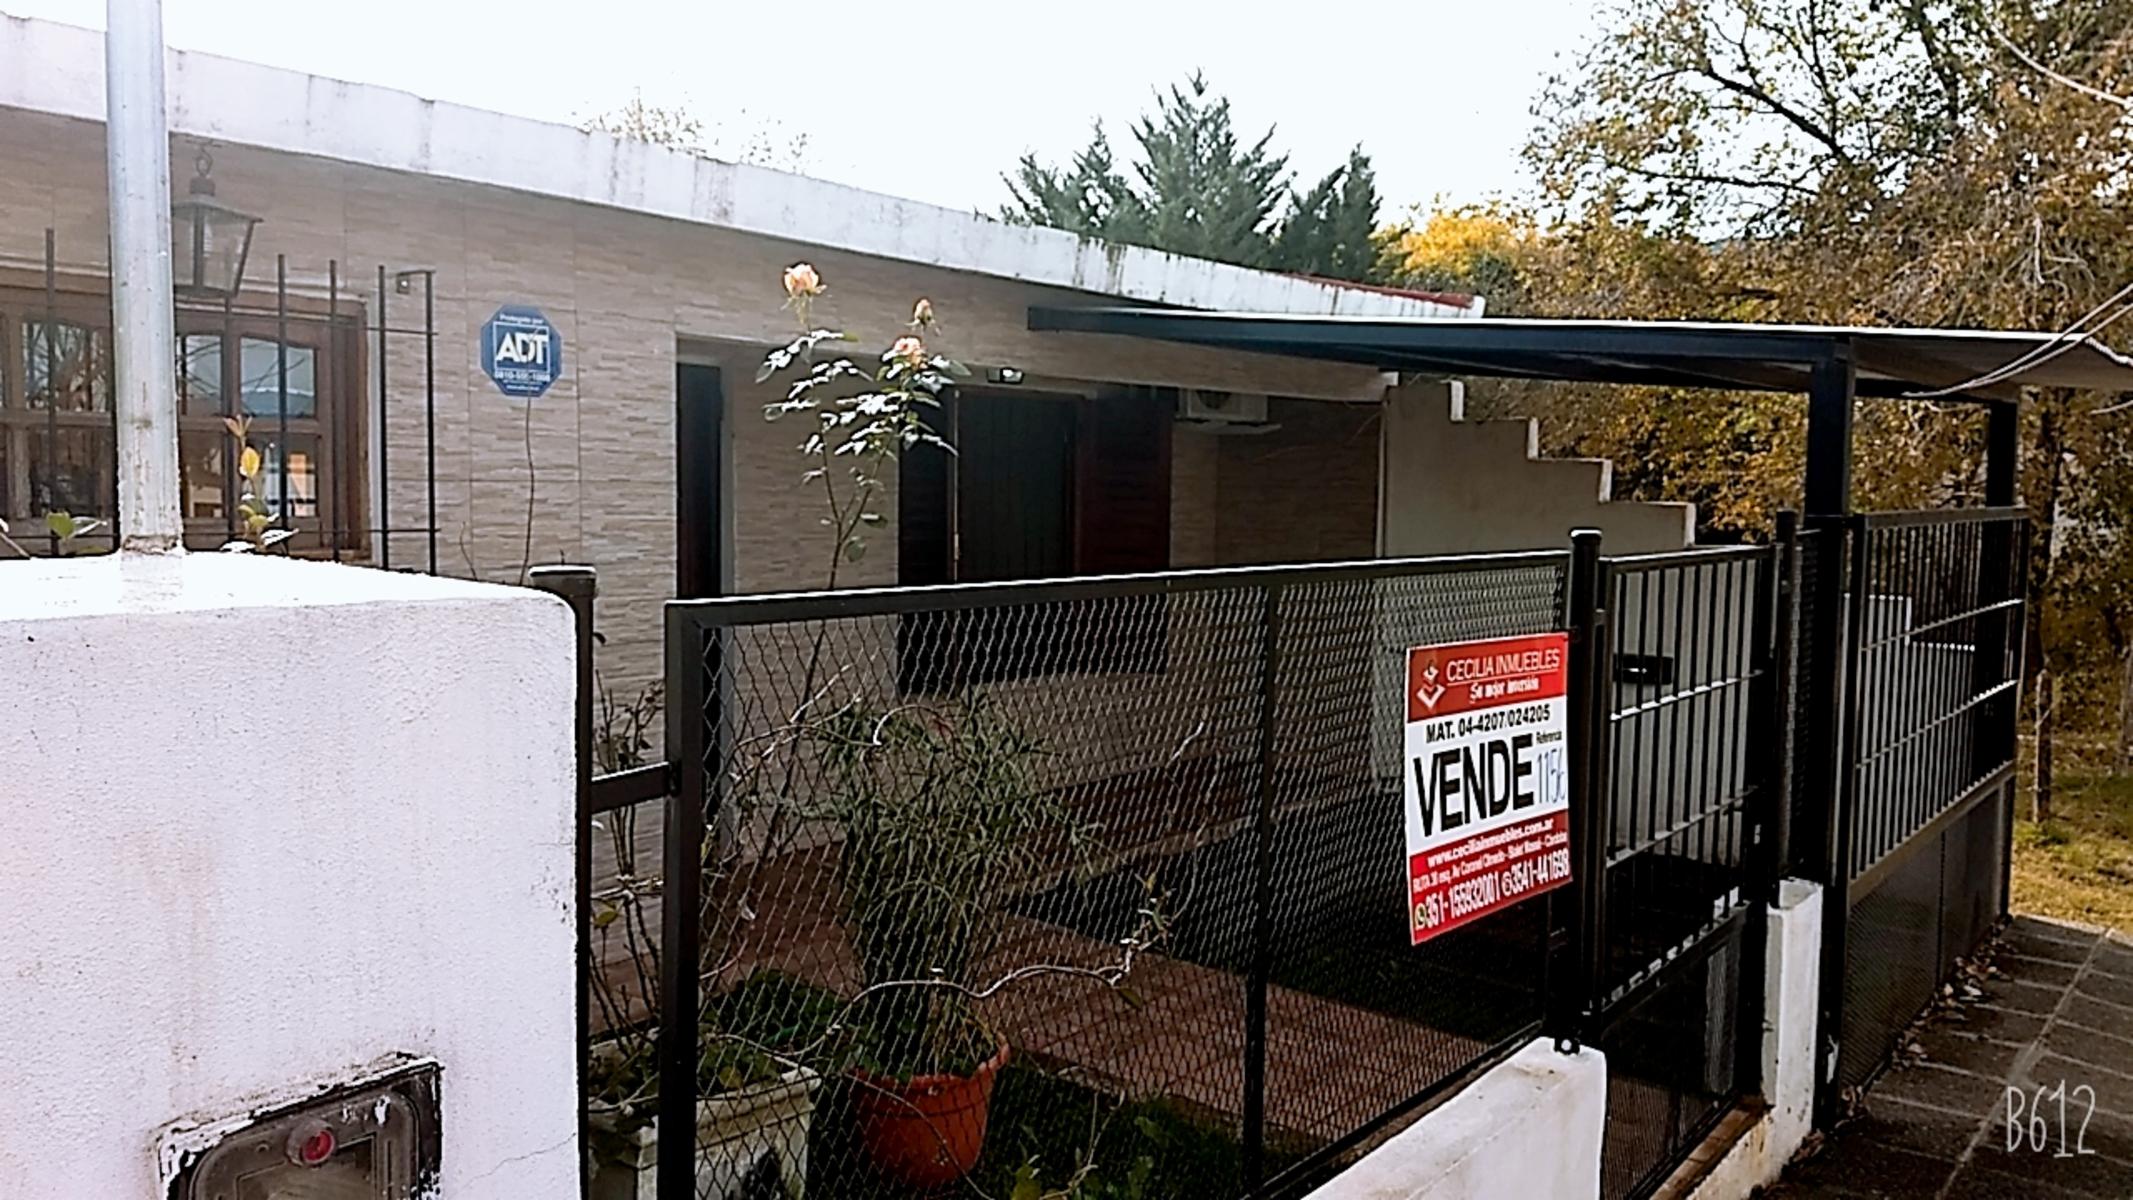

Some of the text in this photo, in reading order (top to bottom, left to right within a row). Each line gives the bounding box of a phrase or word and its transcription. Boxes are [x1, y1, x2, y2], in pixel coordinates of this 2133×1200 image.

[495, 331, 549, 364] ADT
[1446, 648, 1560, 682] CECILIA INMUEBLES
[1426, 721, 1456, 744] MAT.
[1413, 733, 1534, 837] VENDE
[1427, 818, 1554, 868] www.ceciliainmuebles.com.ar
